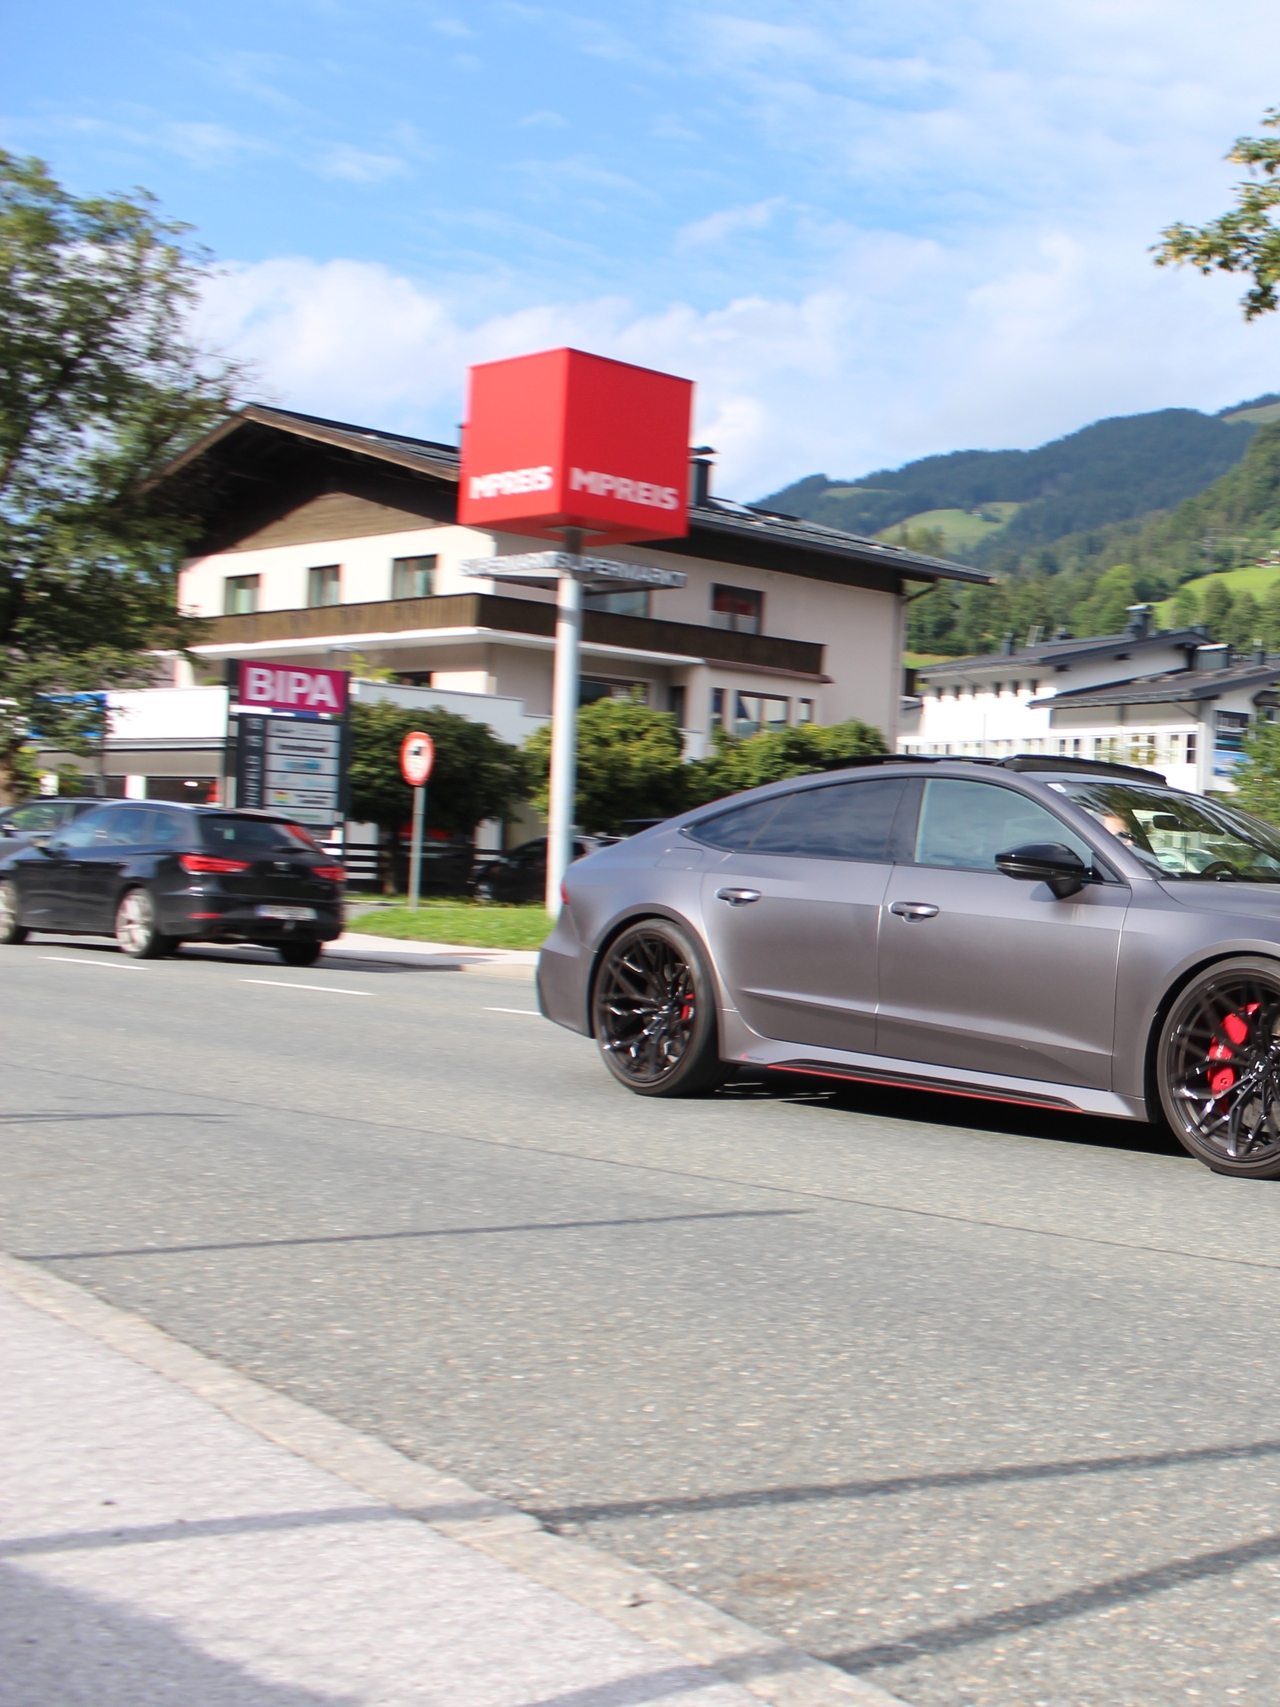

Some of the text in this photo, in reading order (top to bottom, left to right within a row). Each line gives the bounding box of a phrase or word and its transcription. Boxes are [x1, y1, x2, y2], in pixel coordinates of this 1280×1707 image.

[468, 465, 553, 500] MPREIS
[568, 467, 679, 511] MPREIS
[245, 667, 339, 708] BIPA
